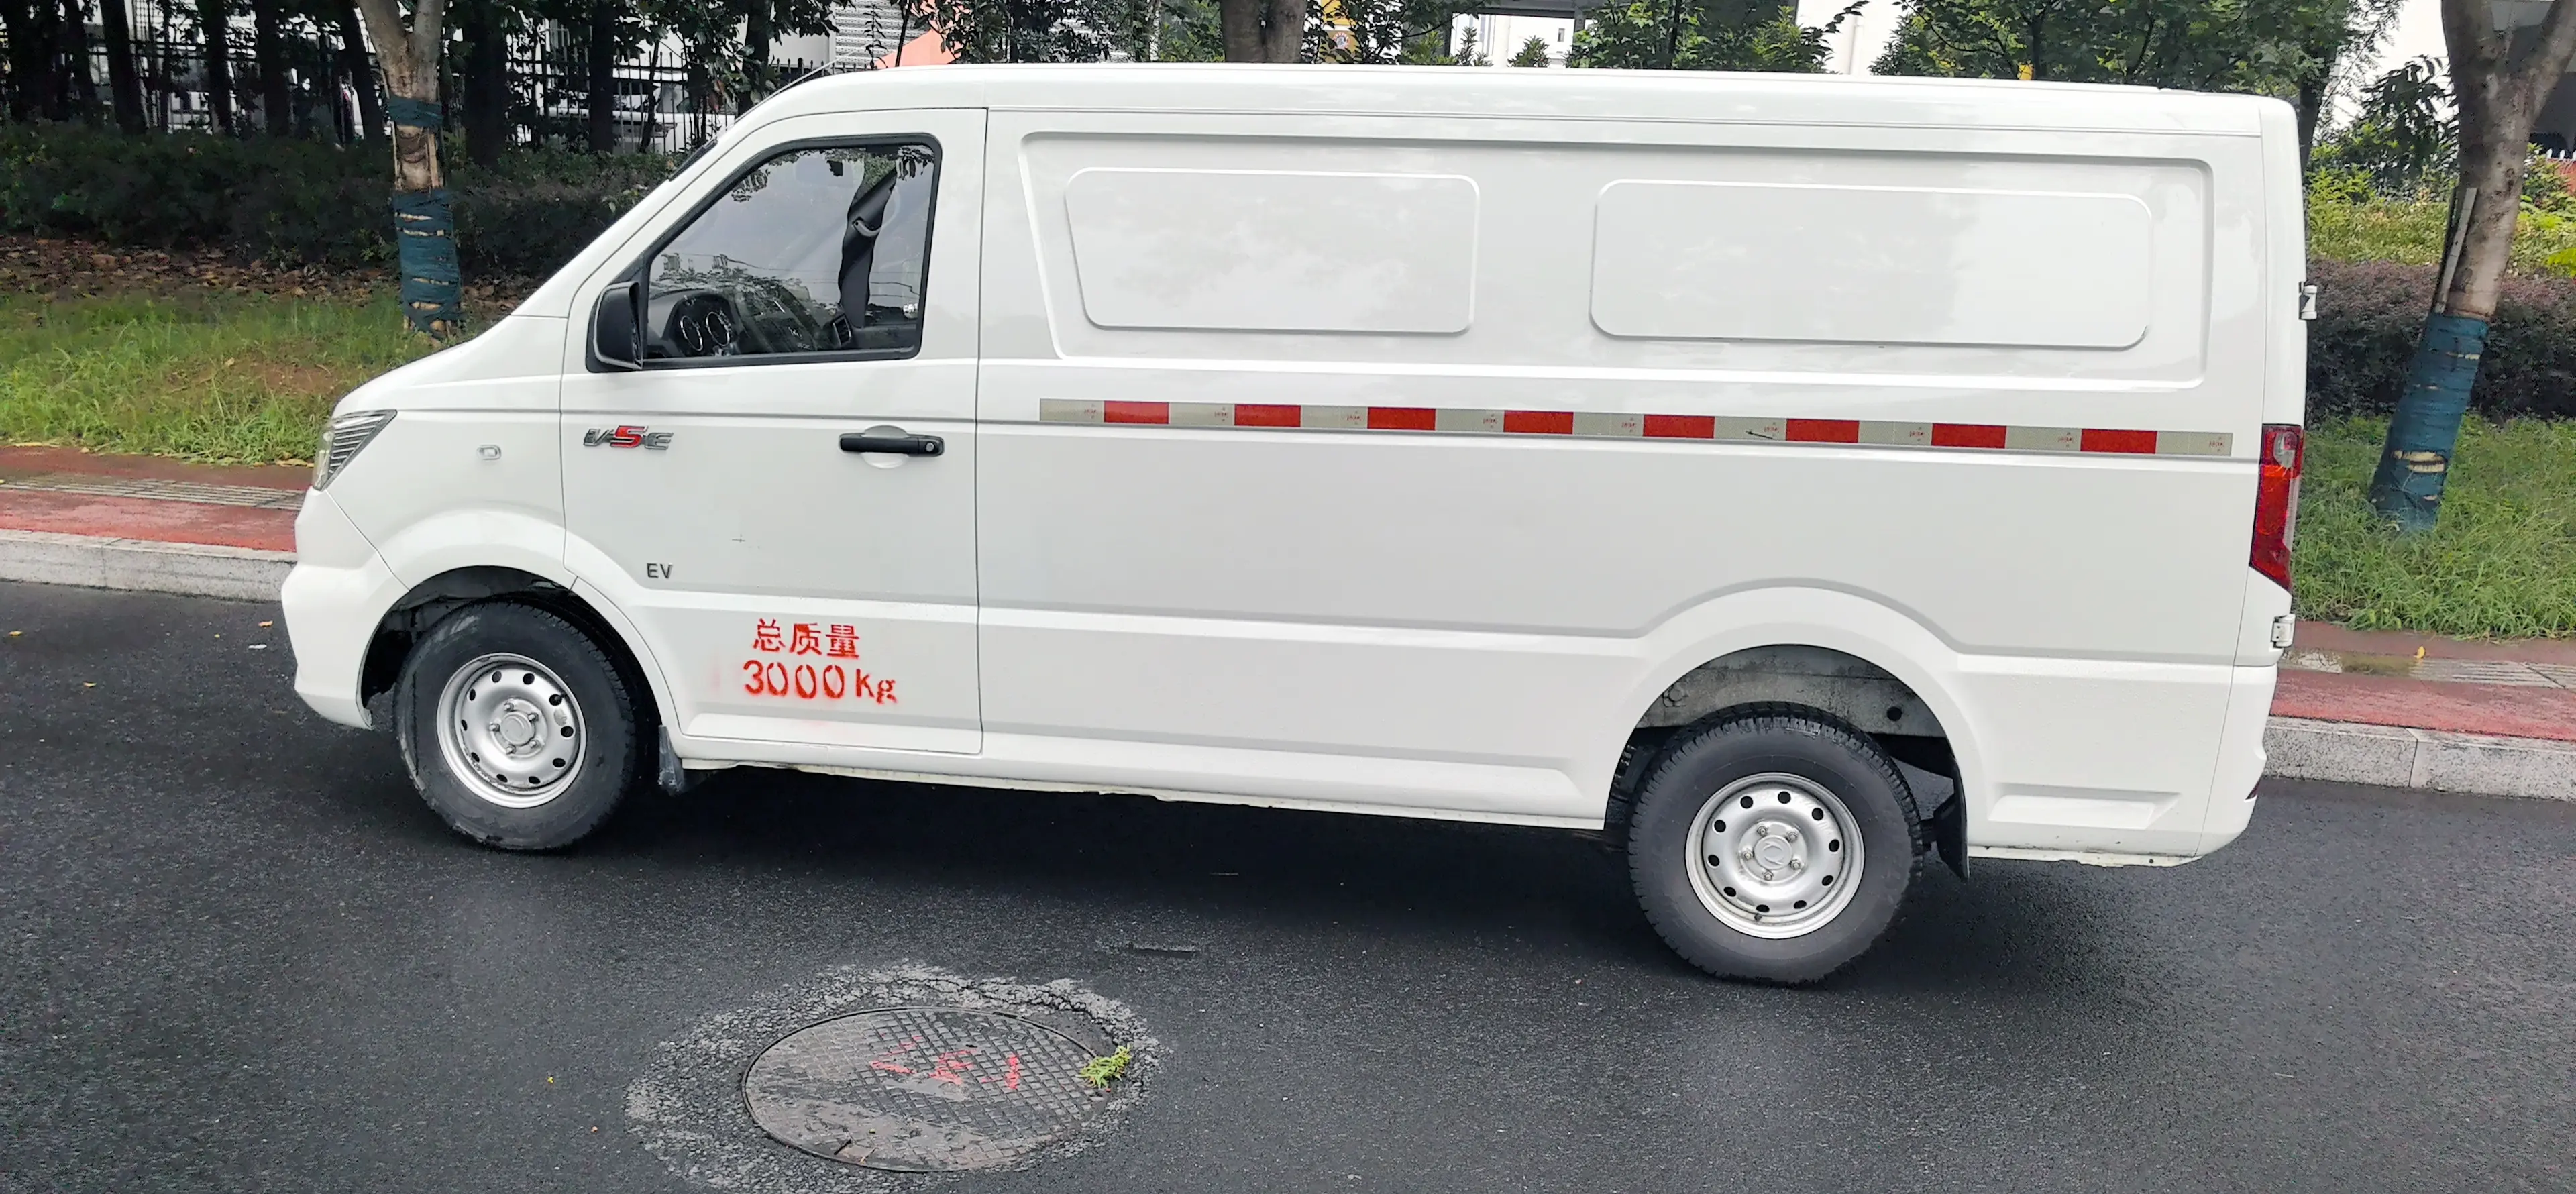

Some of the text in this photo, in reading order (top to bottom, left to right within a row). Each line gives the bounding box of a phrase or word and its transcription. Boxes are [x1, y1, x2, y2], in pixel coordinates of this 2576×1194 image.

[647, 562, 673, 580] EV
[752, 618, 860, 659] 总质量
